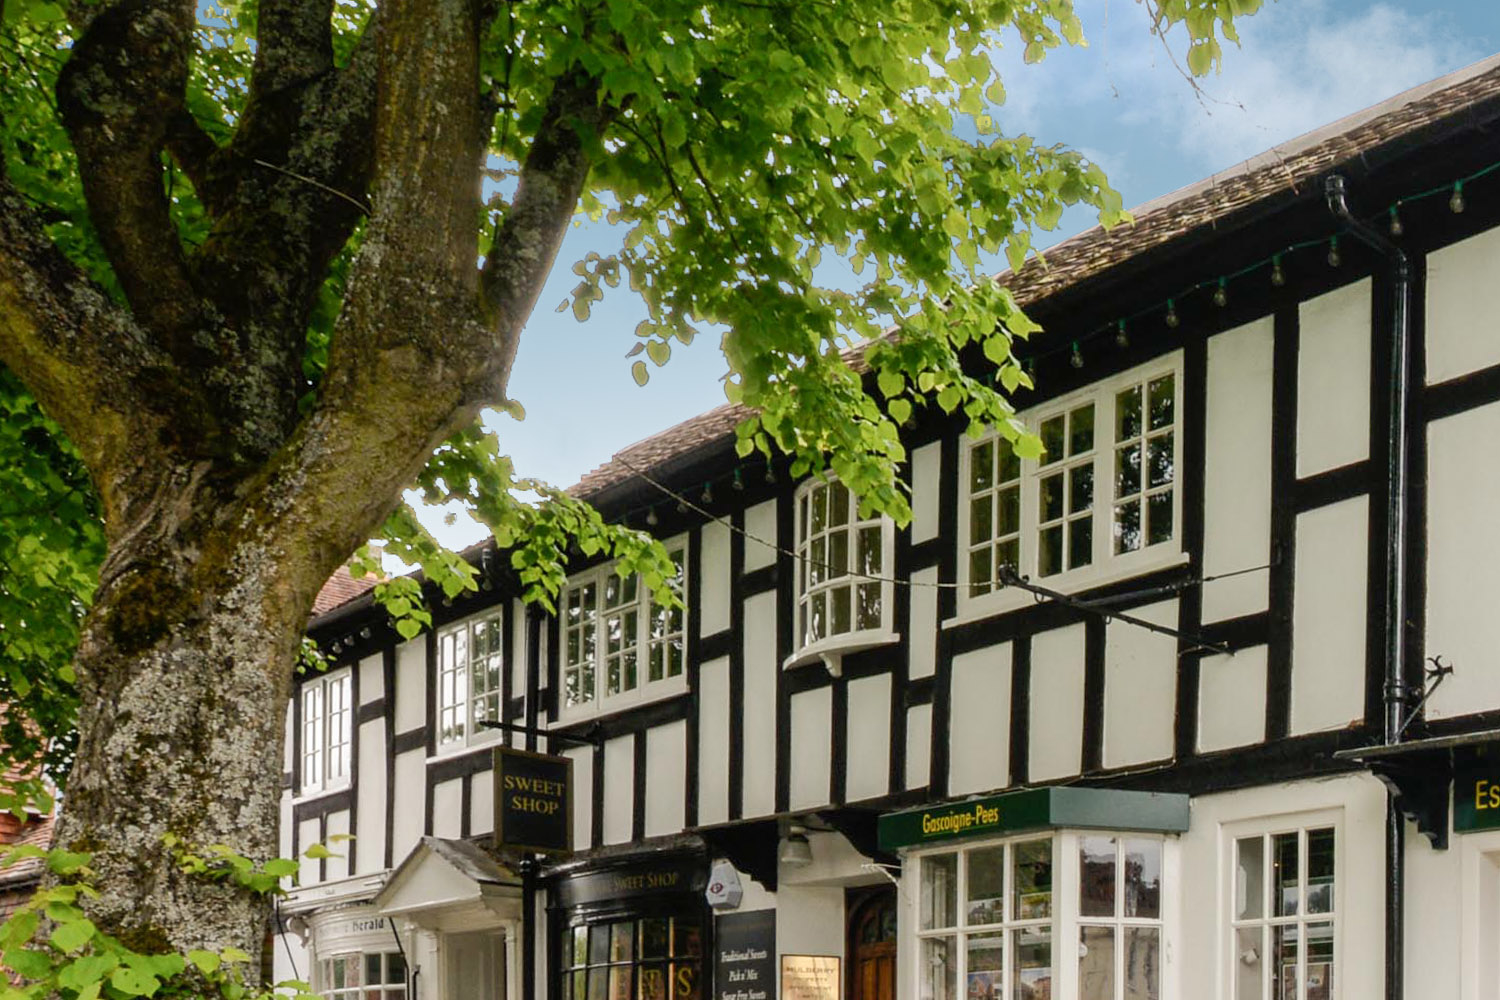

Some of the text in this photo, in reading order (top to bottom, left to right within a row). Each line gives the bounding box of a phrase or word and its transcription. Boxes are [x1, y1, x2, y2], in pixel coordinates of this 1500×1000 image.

[504, 775, 564, 796] SWEET
[511, 795, 559, 815] SHOP
[922, 804, 999, 834] Gascoigne-Pees
